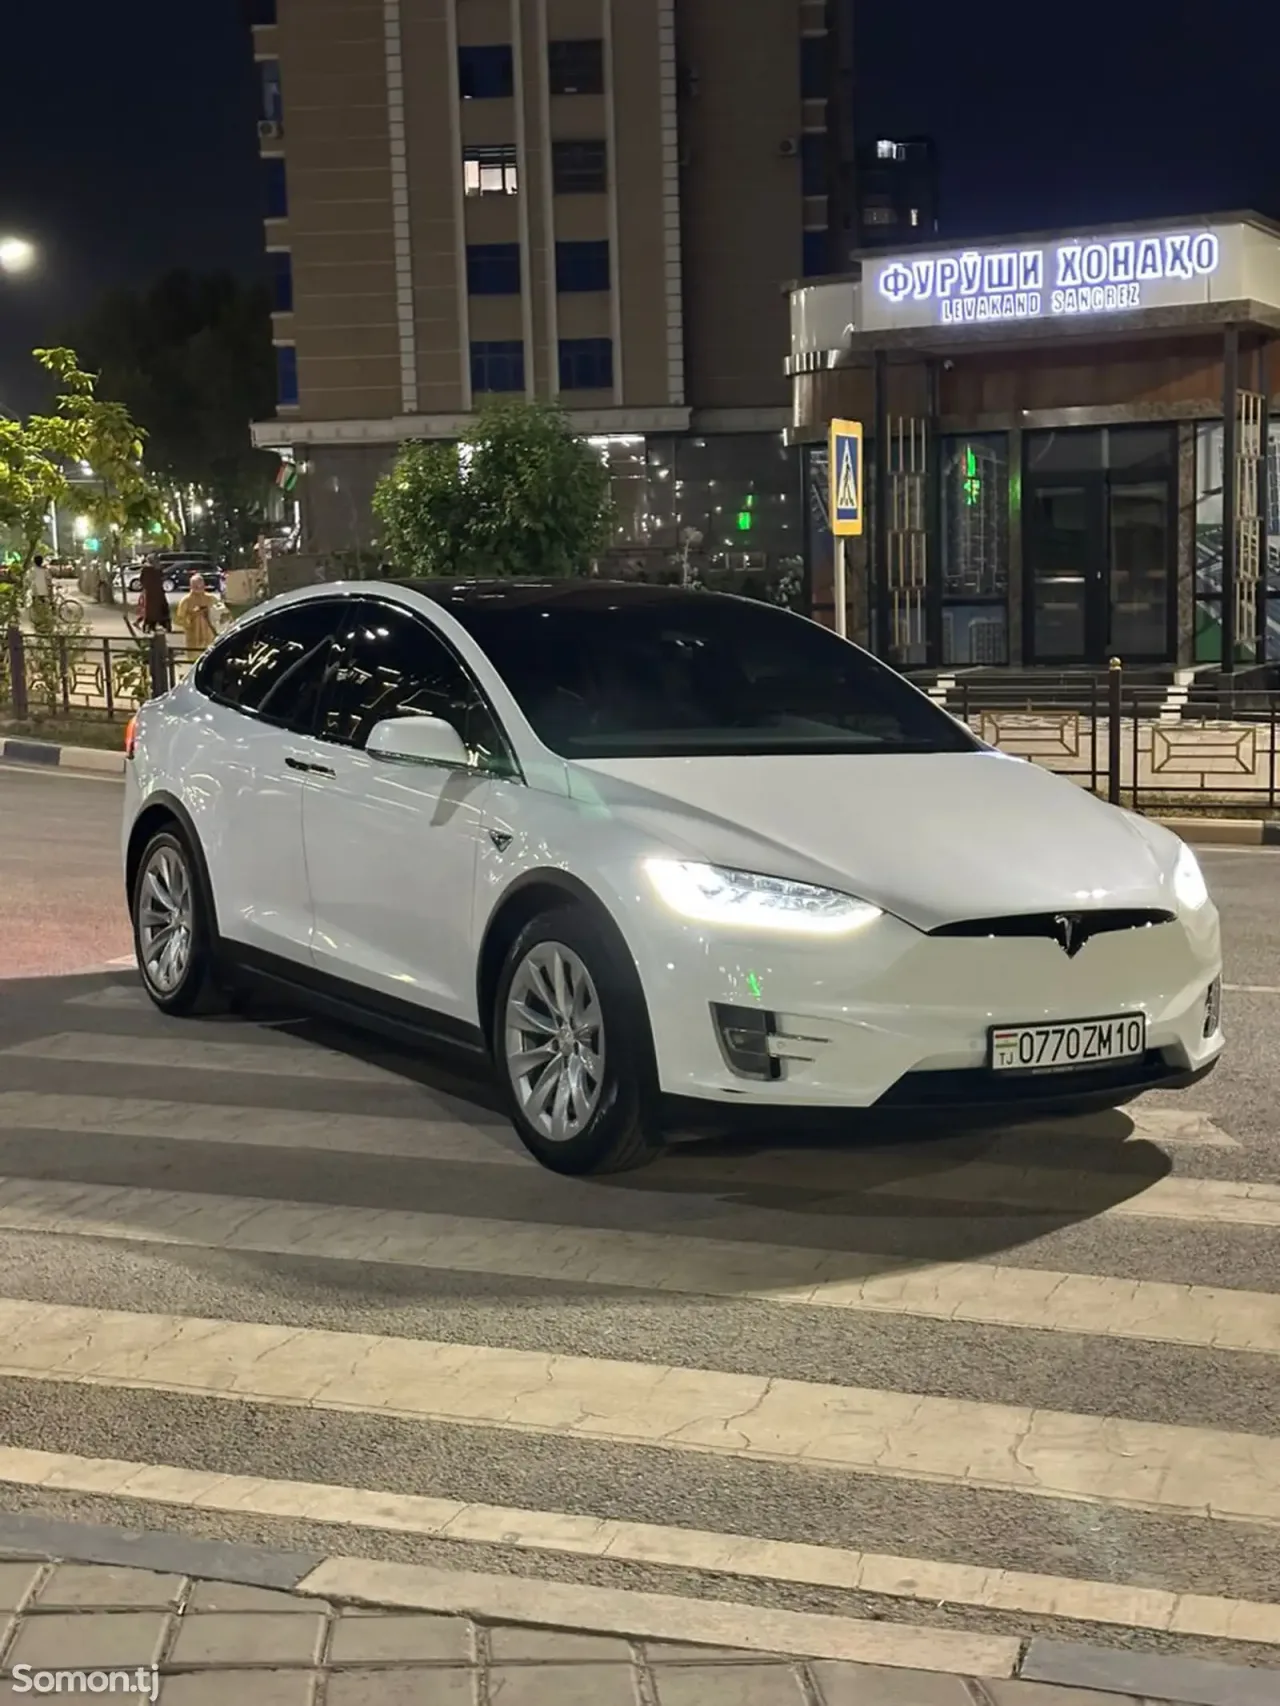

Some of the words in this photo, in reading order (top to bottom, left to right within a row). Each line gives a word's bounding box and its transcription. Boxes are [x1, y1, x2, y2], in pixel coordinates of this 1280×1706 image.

[880, 252, 1043, 301] ФУРӮШИ
[1057, 233, 1218, 286] ХОНАҲО
[942, 294, 1041, 322] LEVAKAND
[999, 1052, 1014, 1065] TJ
[1019, 1021, 1140, 1063] 0770ZM10
